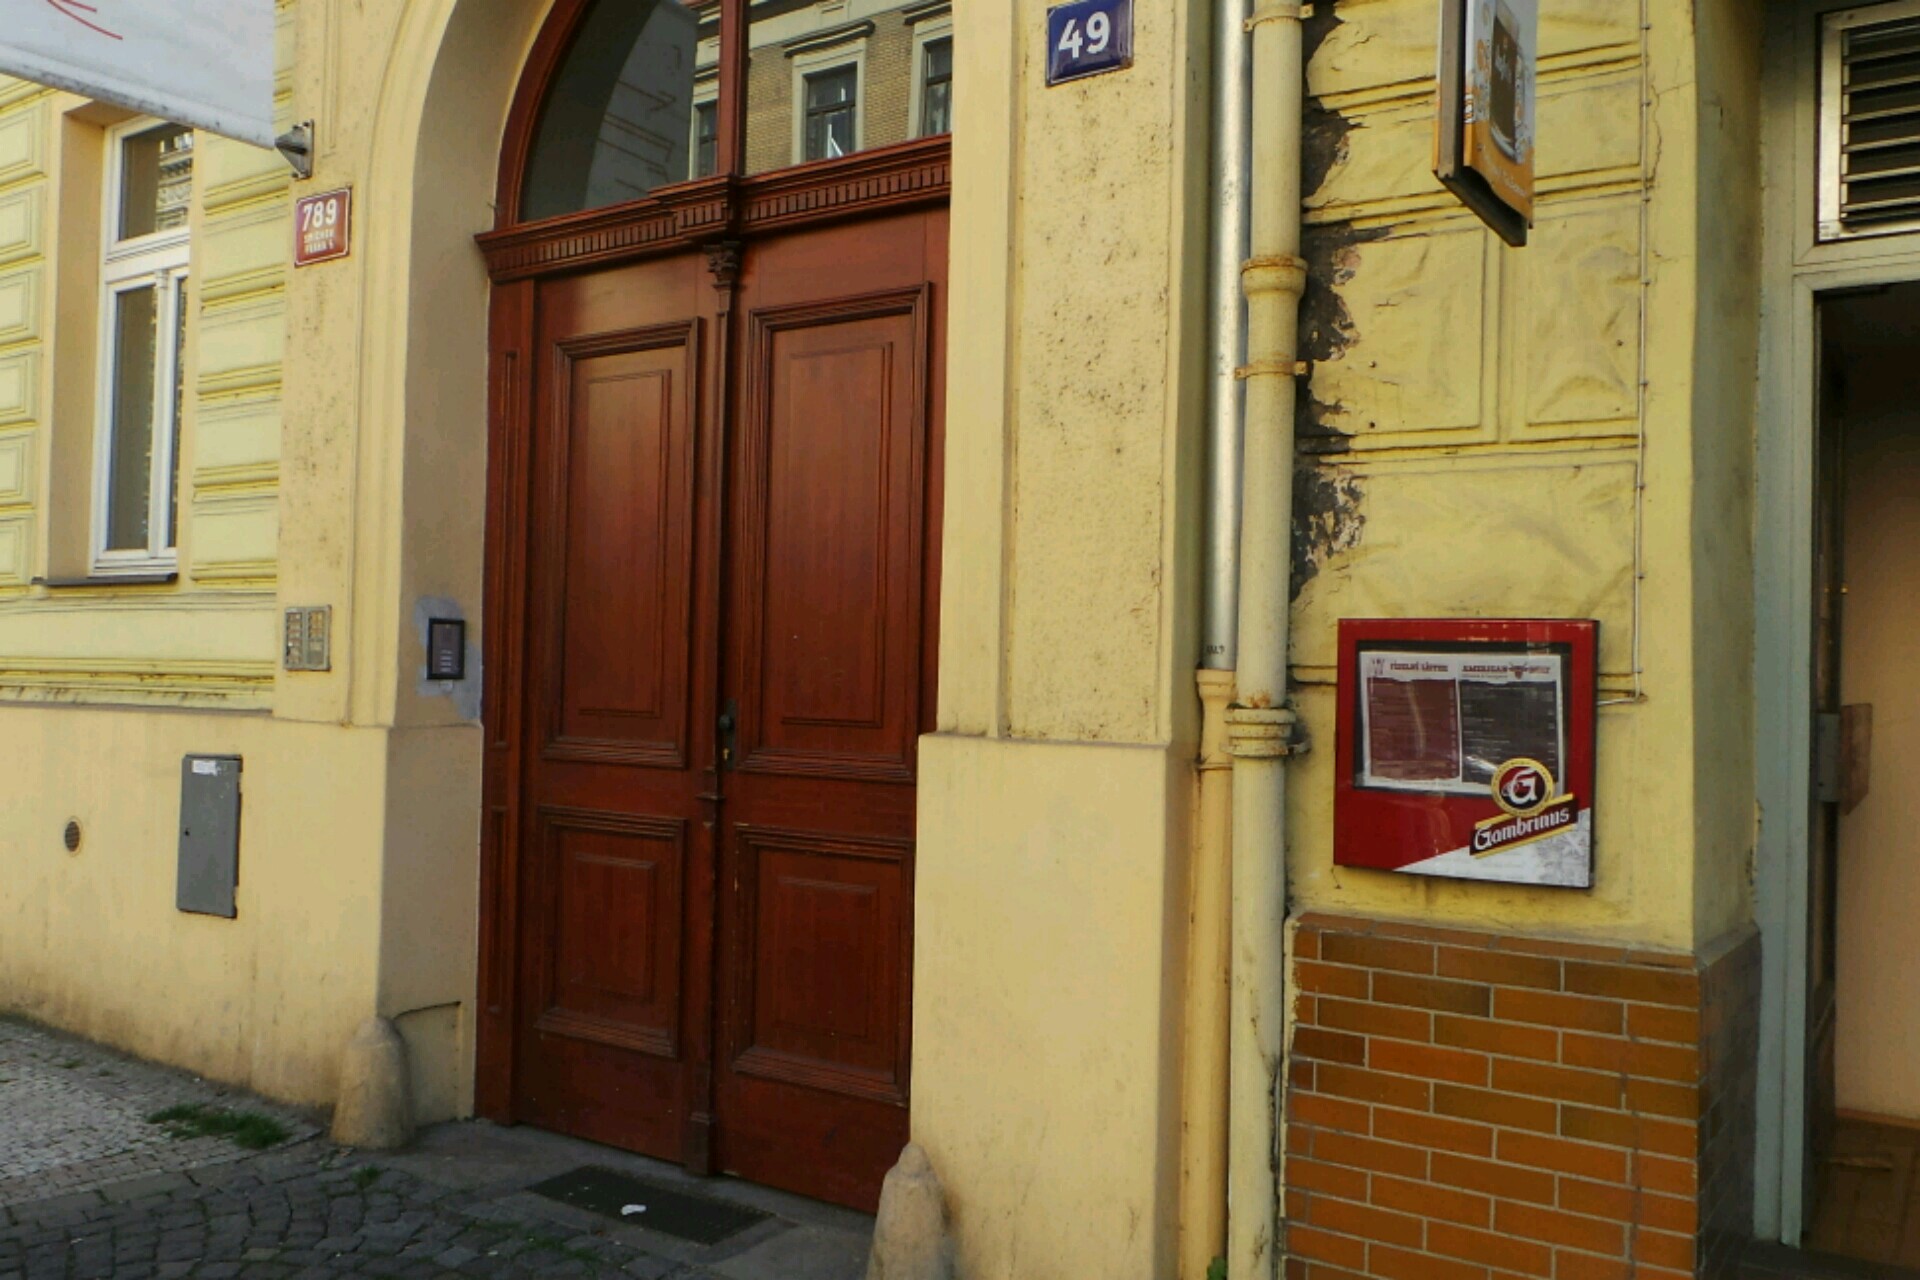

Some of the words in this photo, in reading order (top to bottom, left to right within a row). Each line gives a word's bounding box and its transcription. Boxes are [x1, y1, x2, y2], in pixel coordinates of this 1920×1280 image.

[1058, 11, 1110, 59] 49
[302, 198, 336, 231] 789
[1474, 808, 1570, 851] Gambrinus
